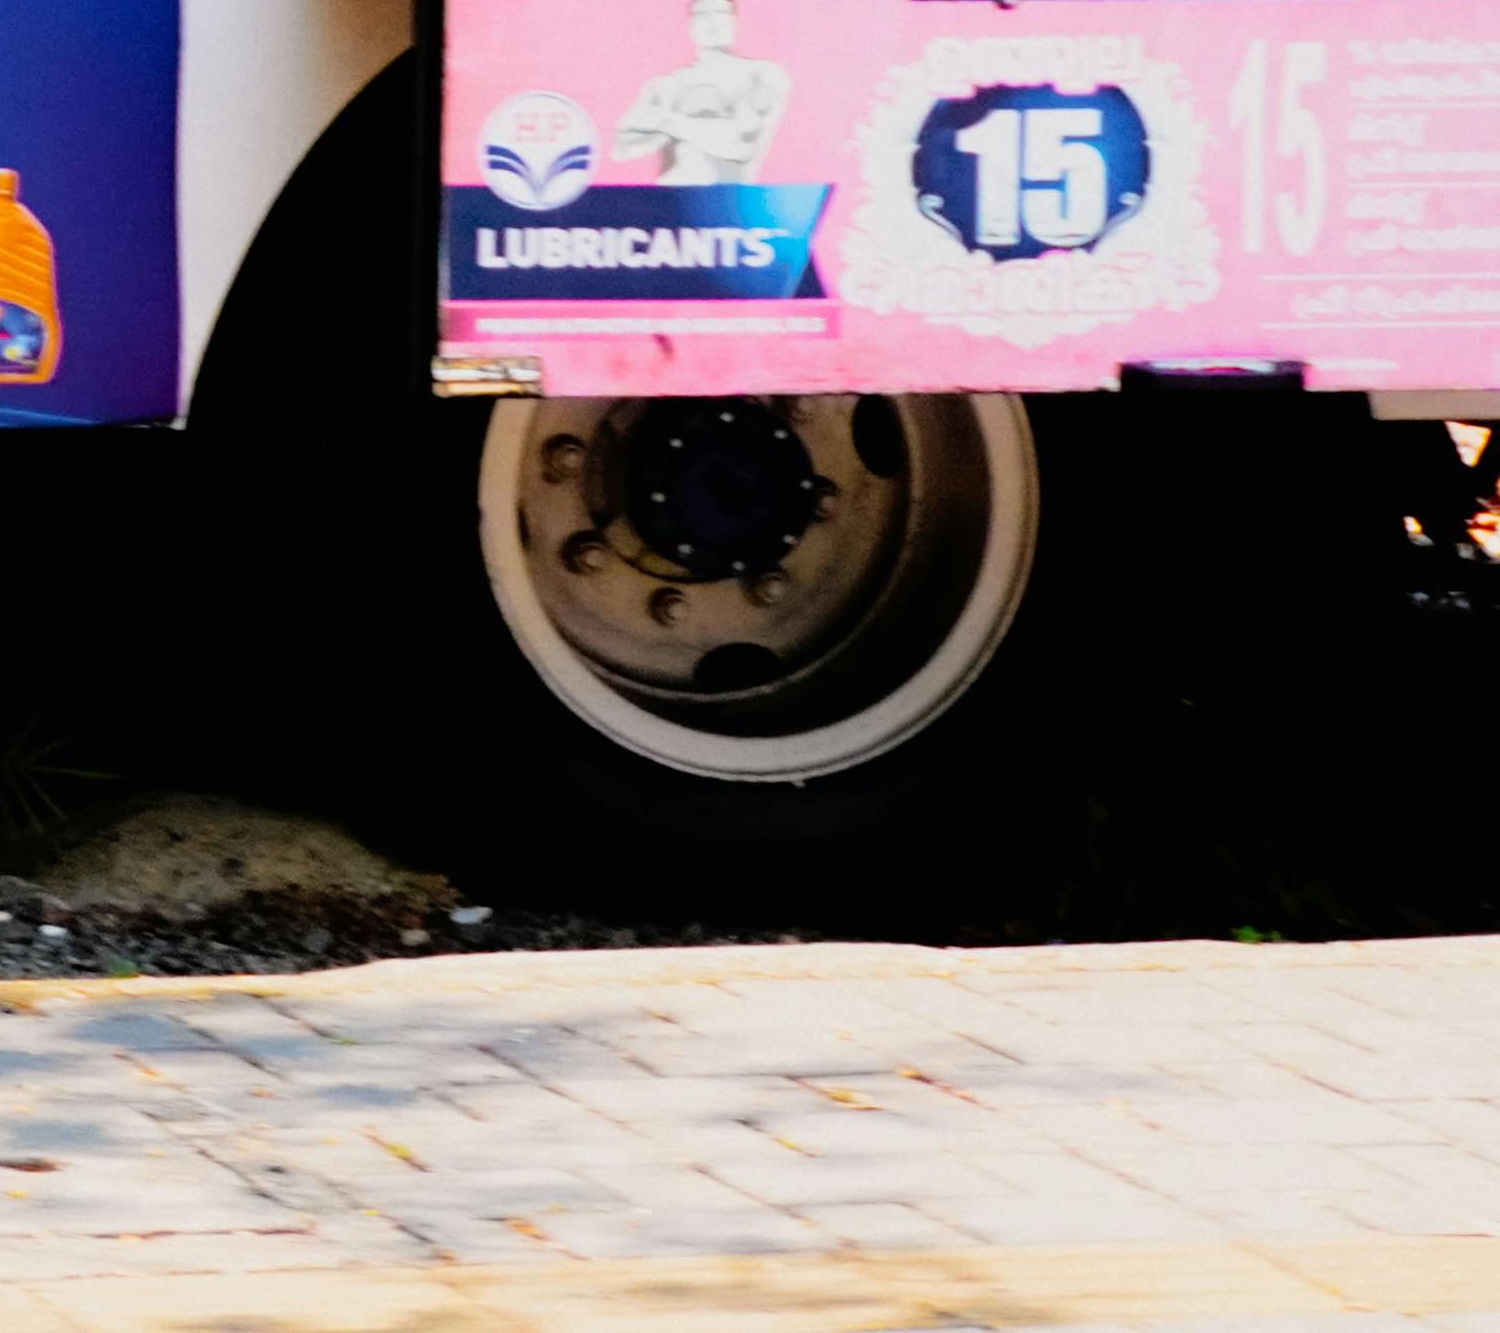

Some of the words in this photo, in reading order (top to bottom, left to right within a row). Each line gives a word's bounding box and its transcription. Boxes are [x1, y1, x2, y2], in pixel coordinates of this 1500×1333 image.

[956, 108, 1109, 247] 15
[1228, 38, 1327, 256] 15
[475, 227, 778, 269] LUBRICANTS
